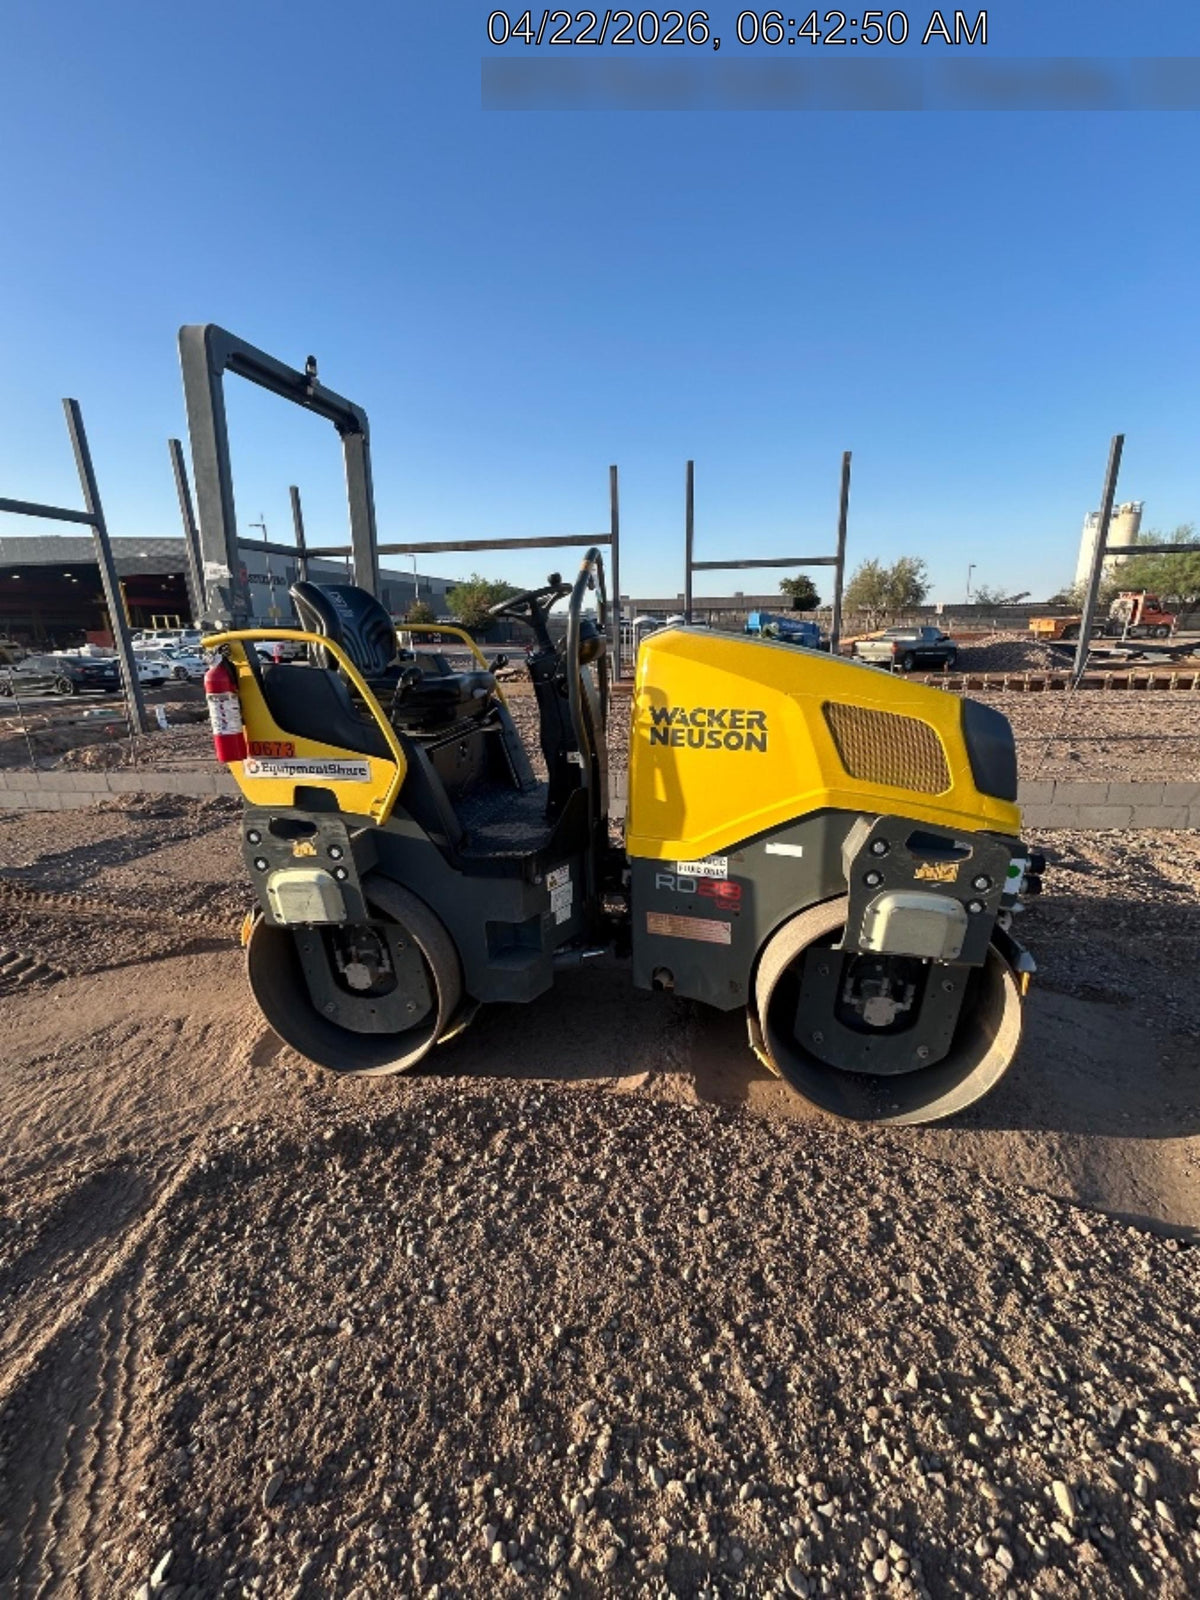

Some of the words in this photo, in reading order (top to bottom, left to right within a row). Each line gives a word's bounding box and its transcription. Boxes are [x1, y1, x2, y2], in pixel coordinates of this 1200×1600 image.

[649, 706, 768, 731] WACKER
[650, 726, 767, 752] NEUSON
[261, 761, 367, 776] EquipmentShare
